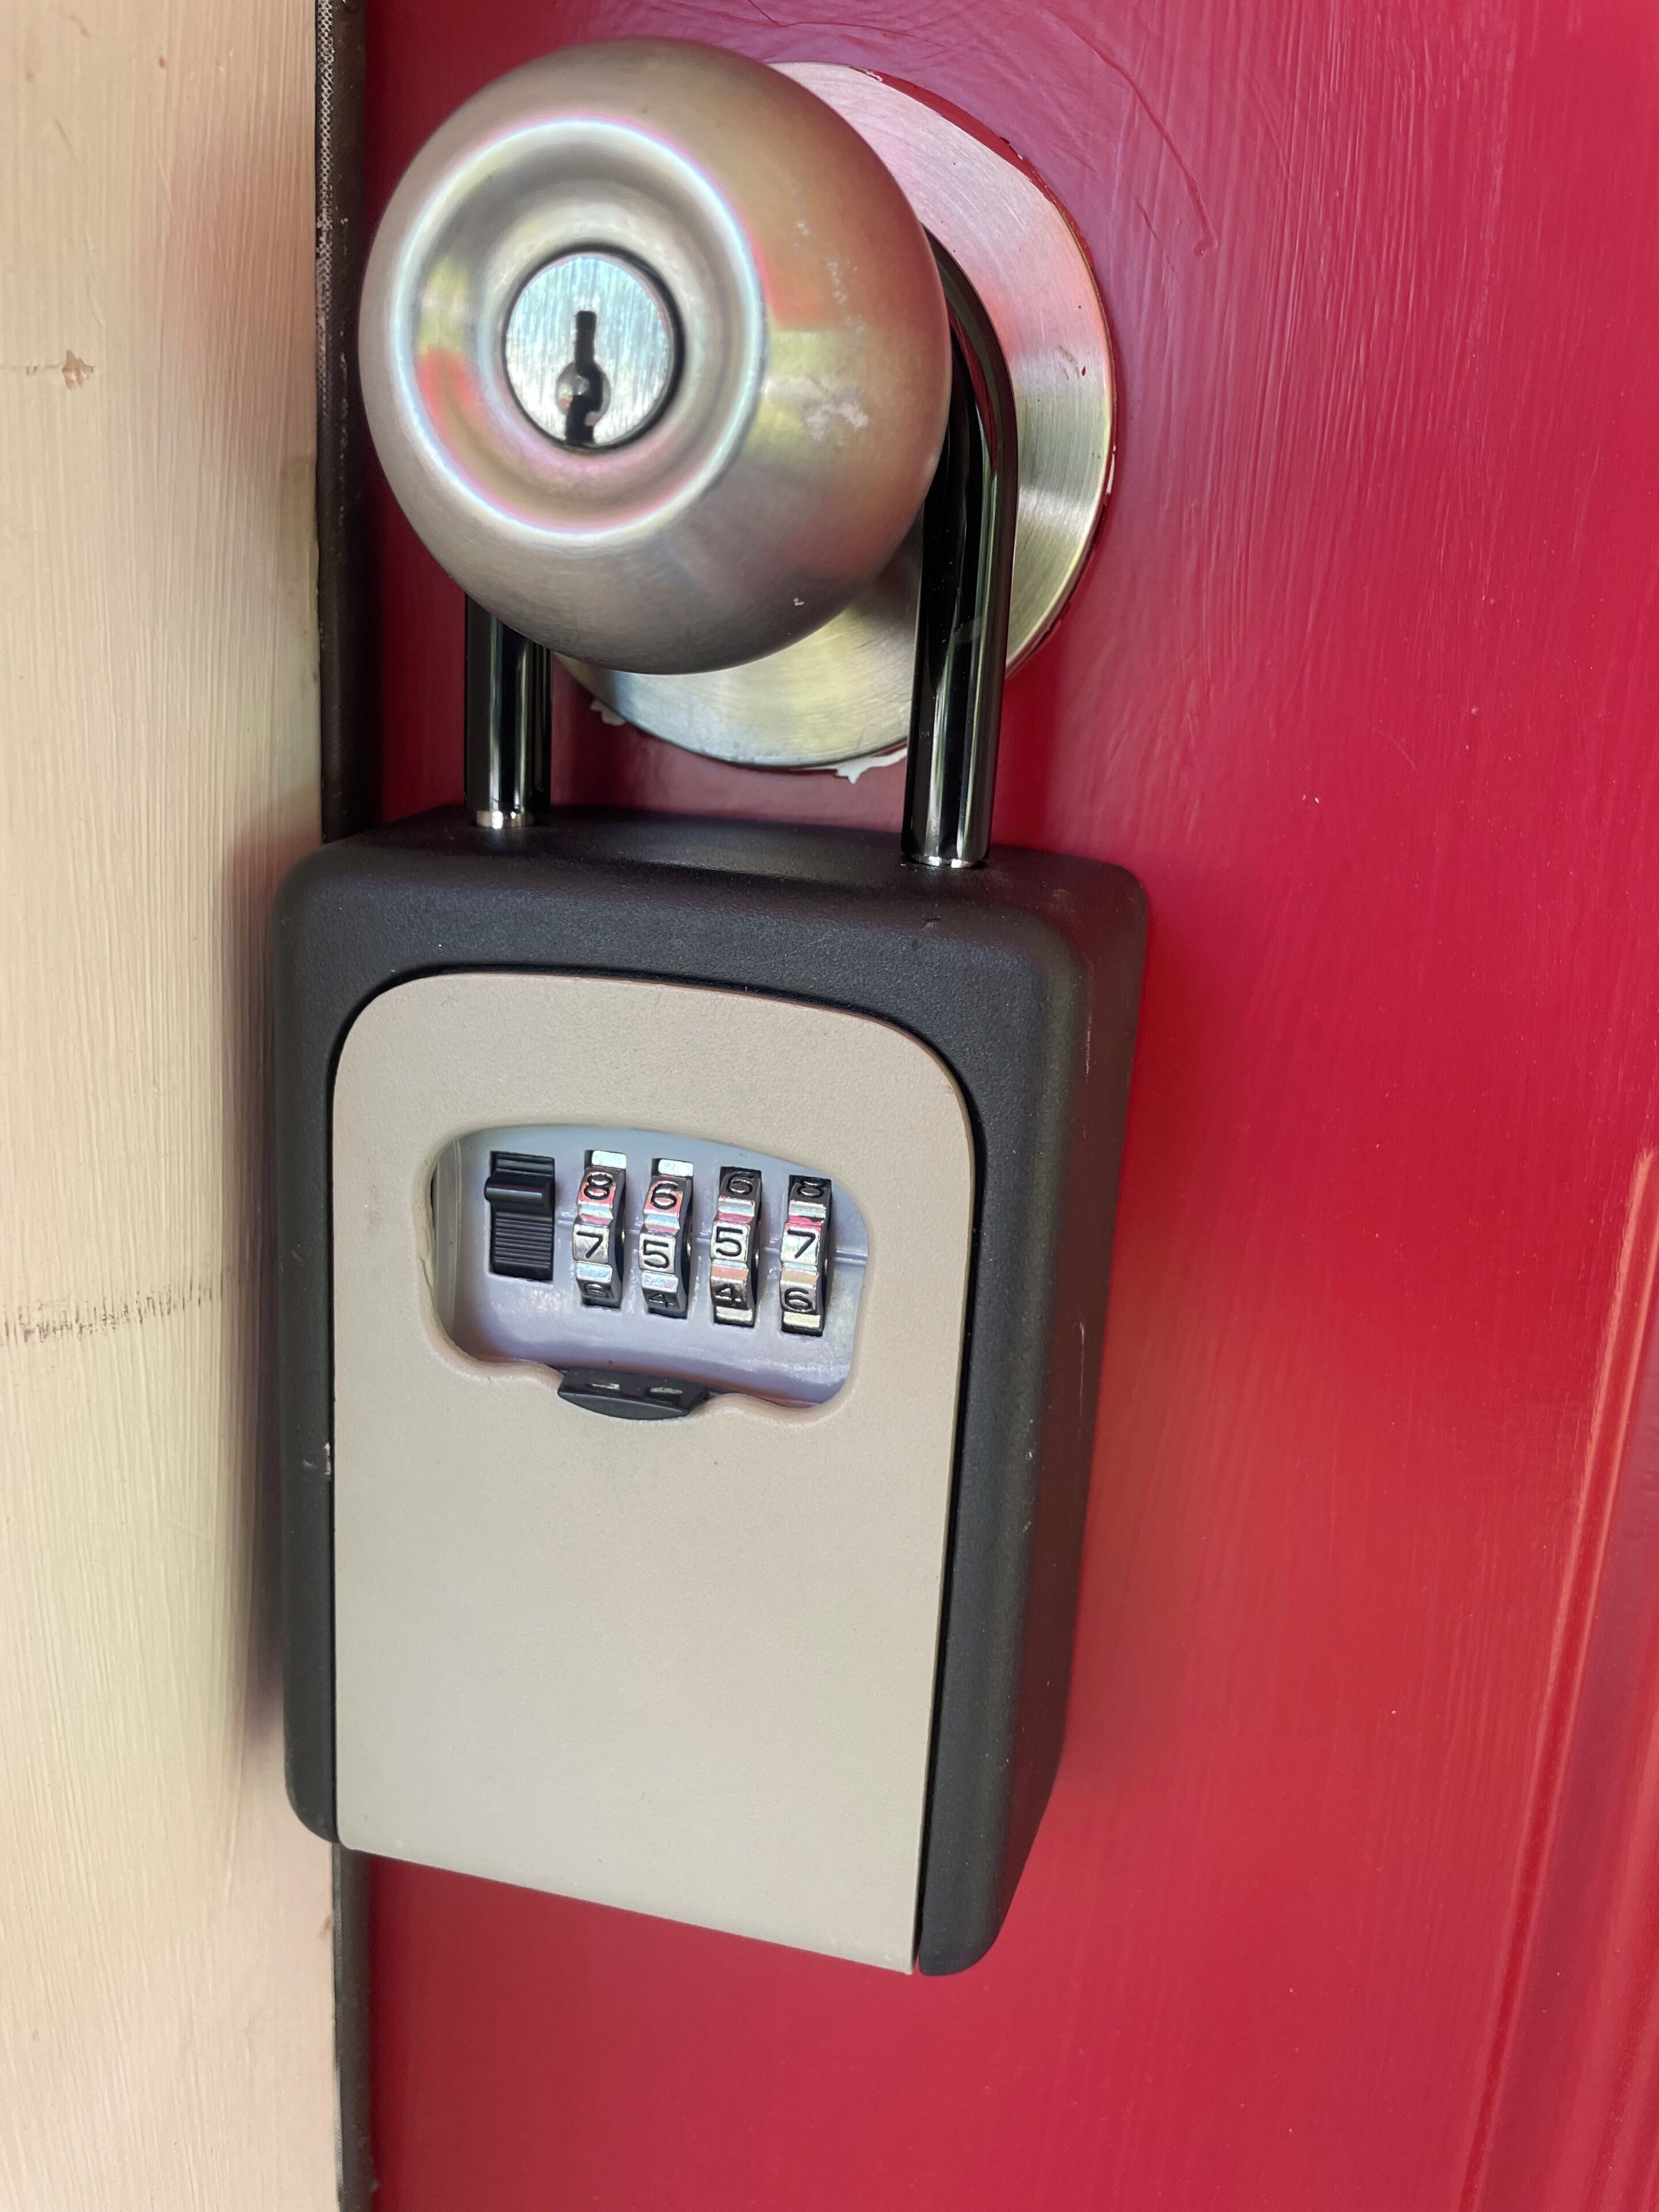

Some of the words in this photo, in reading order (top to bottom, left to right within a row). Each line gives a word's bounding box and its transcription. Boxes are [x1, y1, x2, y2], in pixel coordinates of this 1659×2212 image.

[584, 1171, 613, 1200] 8
[651, 1181, 679, 1210] 6
[726, 1172, 753, 1195] 6
[576, 1230, 604, 1259] 7
[643, 1239, 669, 1268] 5
[716, 1226, 743, 1257] 5
[787, 1228, 816, 1259] 7
[647, 1293, 675, 1308] 4
[714, 1283, 743, 1304] 4
[784, 1288, 813, 1310] 6
